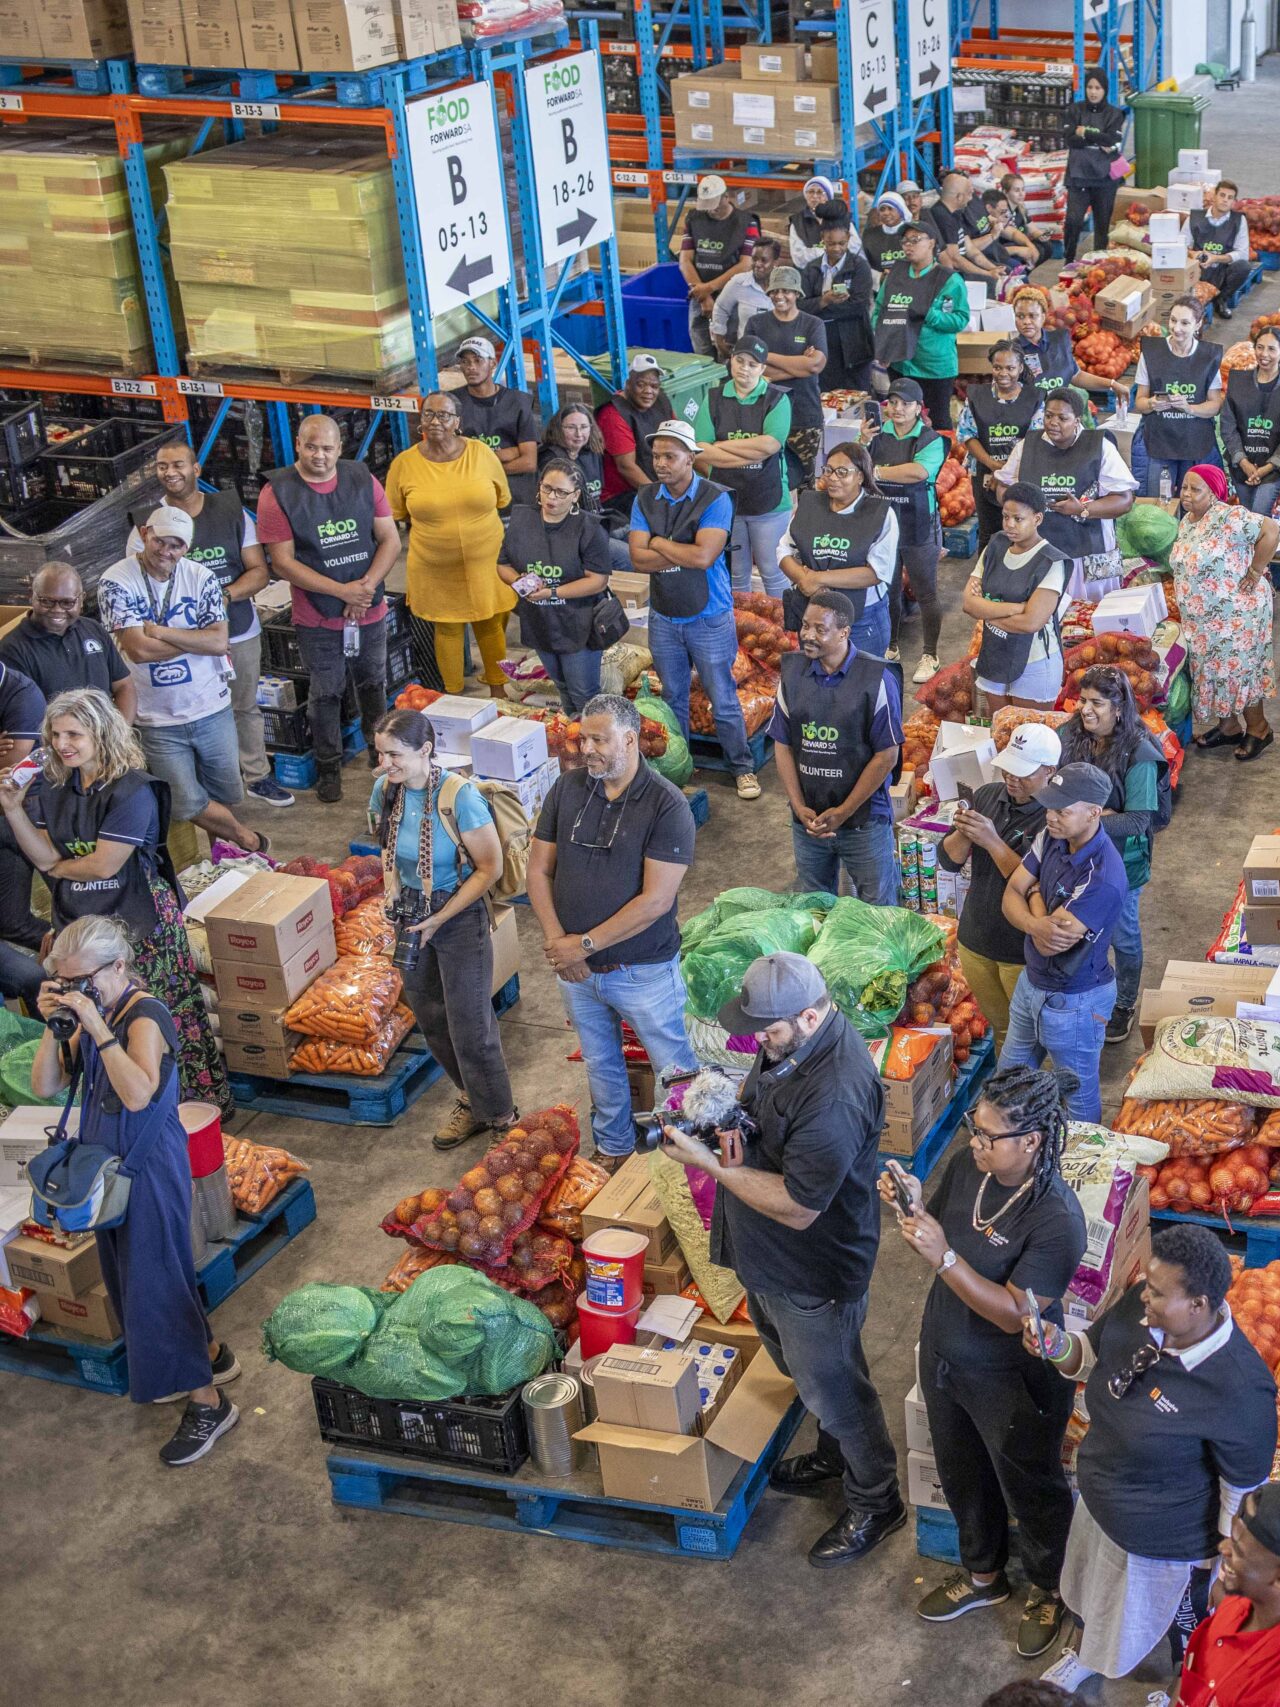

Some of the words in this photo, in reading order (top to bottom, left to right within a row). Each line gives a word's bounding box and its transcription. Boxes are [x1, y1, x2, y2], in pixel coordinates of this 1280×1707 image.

[866, 12, 879, 49] C
[917, 34, 941, 57] 18-26
[860, 56, 886, 81] 05-13
[543, 64, 581, 96] FOOD
[546, 90, 574, 108] FORWARD
[235, 105, 263, 117] B-13-3
[427, 96, 469, 130] FOOD
[430, 127, 463, 145] FORWARD
[561, 117, 578, 165] B
[447, 155, 467, 206] B
[553, 171, 594, 206] 18-26
[438, 212, 488, 252] 05-13
[114, 382, 141, 393] B-12-2
[180, 382, 206, 393] B-13-1
[374, 397, 401, 408] B-13-2
[989, 423, 1019, 437] FOOD
[1041, 473, 1075, 487] FOOD
[317, 517, 358, 538] FOOD
[320, 534, 350, 545] FORWARD
[813, 534, 850, 550] FOOD
[323, 552, 369, 568] VOLUNTEER
[801, 721, 839, 741] FOOD
[297, 914, 313, 932] Royco
[230, 936, 256, 947] Royco
[304, 953, 319, 971] Royco
[238, 978, 266, 989] Royco
